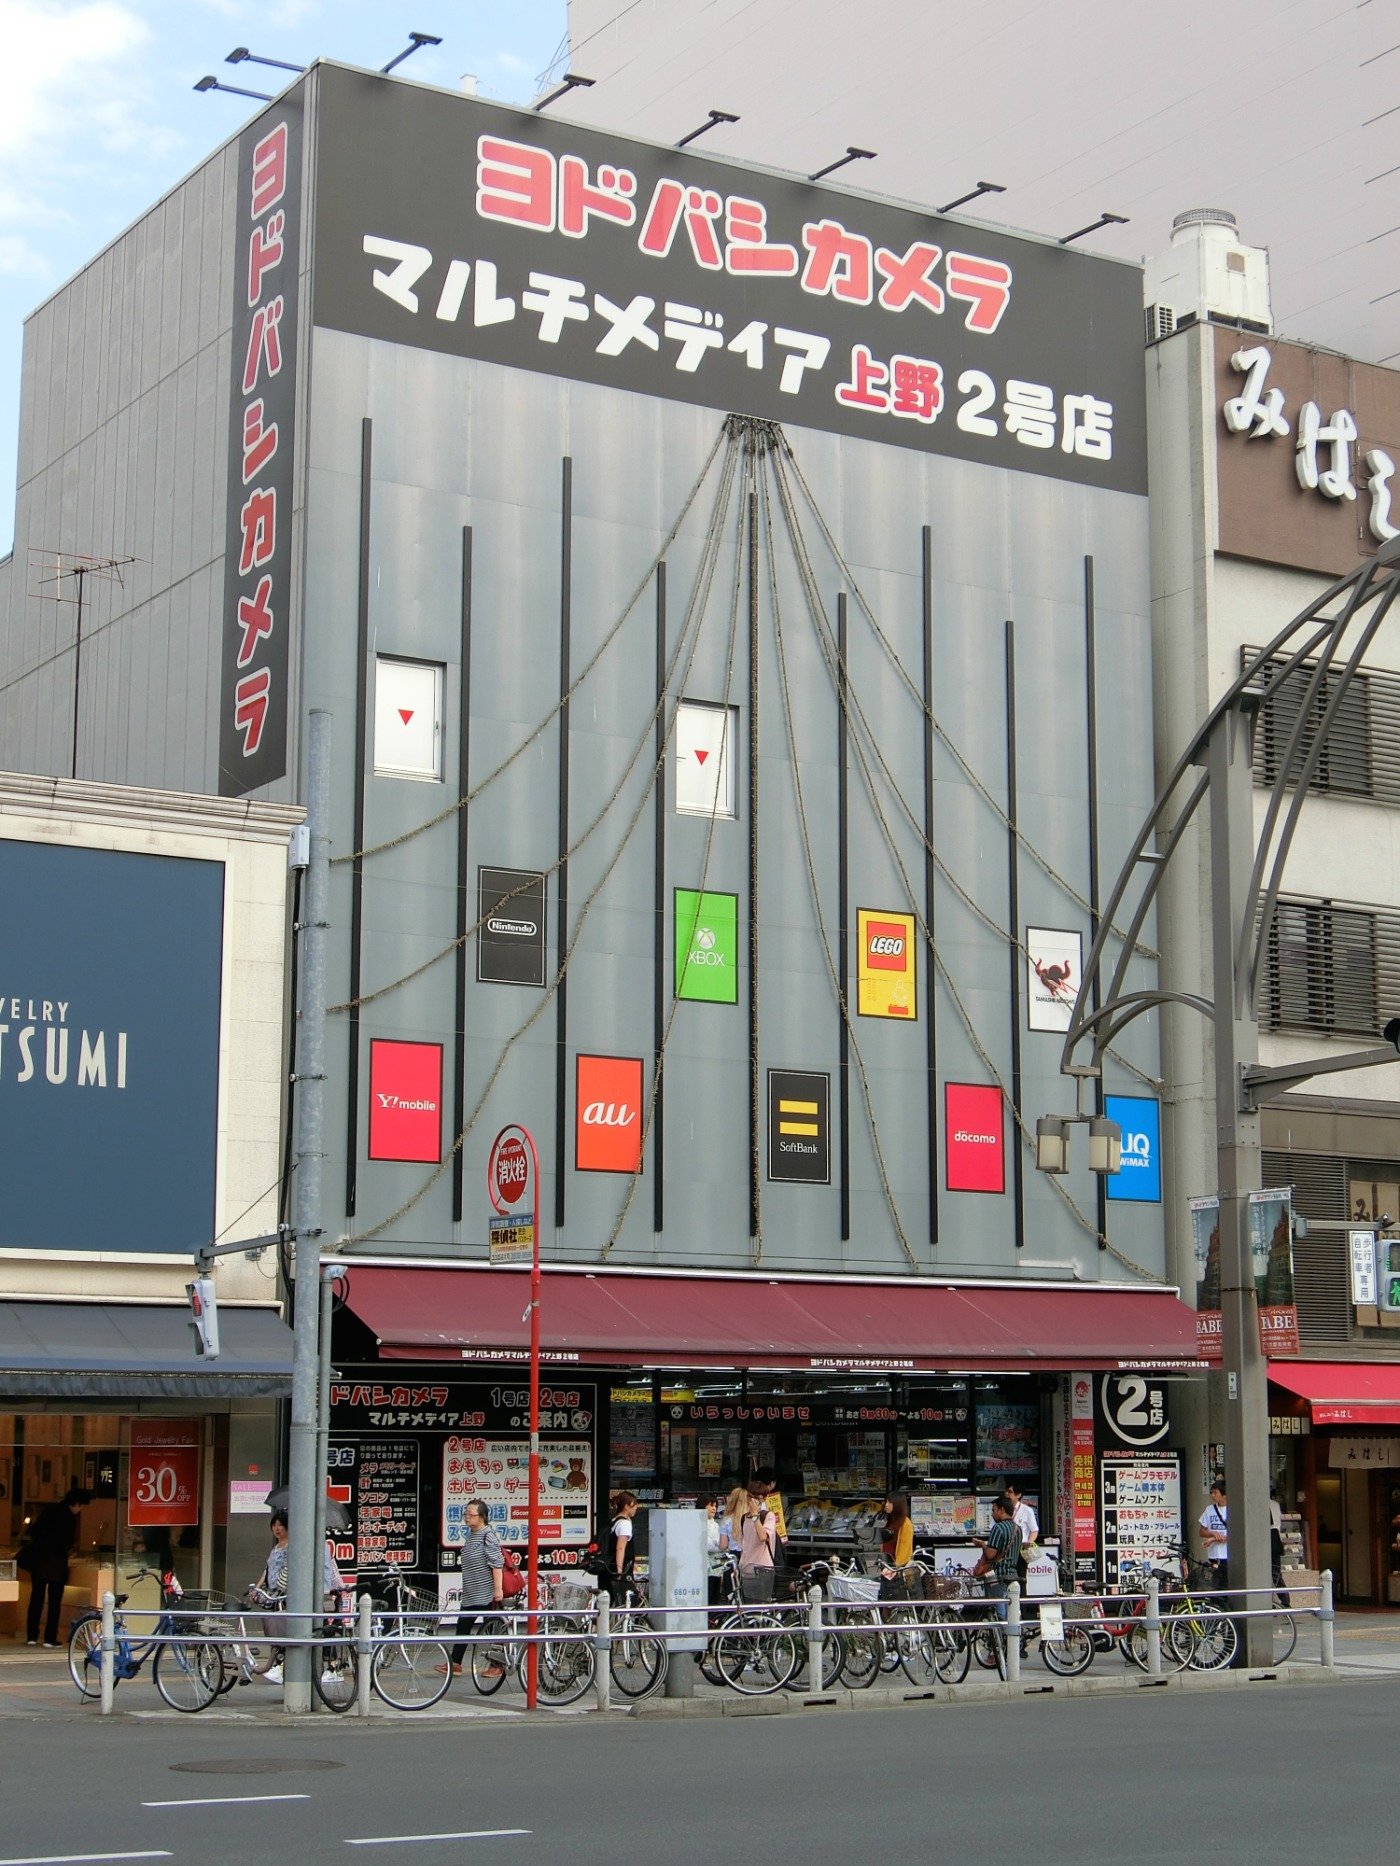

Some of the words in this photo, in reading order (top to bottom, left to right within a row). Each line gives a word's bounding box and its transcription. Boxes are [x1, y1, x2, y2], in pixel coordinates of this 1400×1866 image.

[476, 134, 1013, 335] ヨドバシカメラ
[235, 120, 288, 758] ヨドバシカメラ
[491, 920, 534, 934] Nintendo
[869, 935, 905, 957] LEGO
[687, 950, 725, 967] XBOX
[582, 1100, 636, 1127] au
[954, 1130, 996, 1144] docomo
[1120, 1132, 1152, 1159] UQ
[779, 1140, 819, 1155] SoftBank
[498, 1155, 526, 1186] 消火栓
[1354, 1237, 1363, 1272] 自転車
[1362, 1238, 1373, 1273] 歩行者
[461, 1349, 580, 1361] ヨドバシカメラマルチィア上野2号店
[330, 1385, 449, 1407] ドバシカメラ
[540, 1387, 581, 1408] 2号店
[1116, 1374, 1149, 1426] 2
[690, 1405, 810, 1420] いらっしゃいませ
[1150, 1390, 1163, 1426] 号店
[1272, 1419, 1299, 1430] みはし
[136, 1435, 151, 1444] Gold
[154, 1435, 179, 1446] Jewelry
[181, 1435, 194, 1444] Fair
[447, 1435, 487, 1454] 2号店
[1074, 1454, 1094, 1467] 免税
[1347, 1447, 1384, 1461] みはし
[448, 1457, 503, 1474] おもちゃ
[1074, 1467, 1094, 1479] 商店
[136, 1467, 177, 1502] 30
[176, 1494, 190, 1502] OFF
[1118, 1494, 1164, 1504] ゲームソフト
[358, 1506, 392, 1519] 活家電
[446, 1503, 507, 1522] 携話
[1119, 1509, 1178, 1519] おもちゃ・ホビー
[447, 1525, 530, 1541] スマフォン
[1119, 1534, 1177, 1545] 玩具・フィギュア
